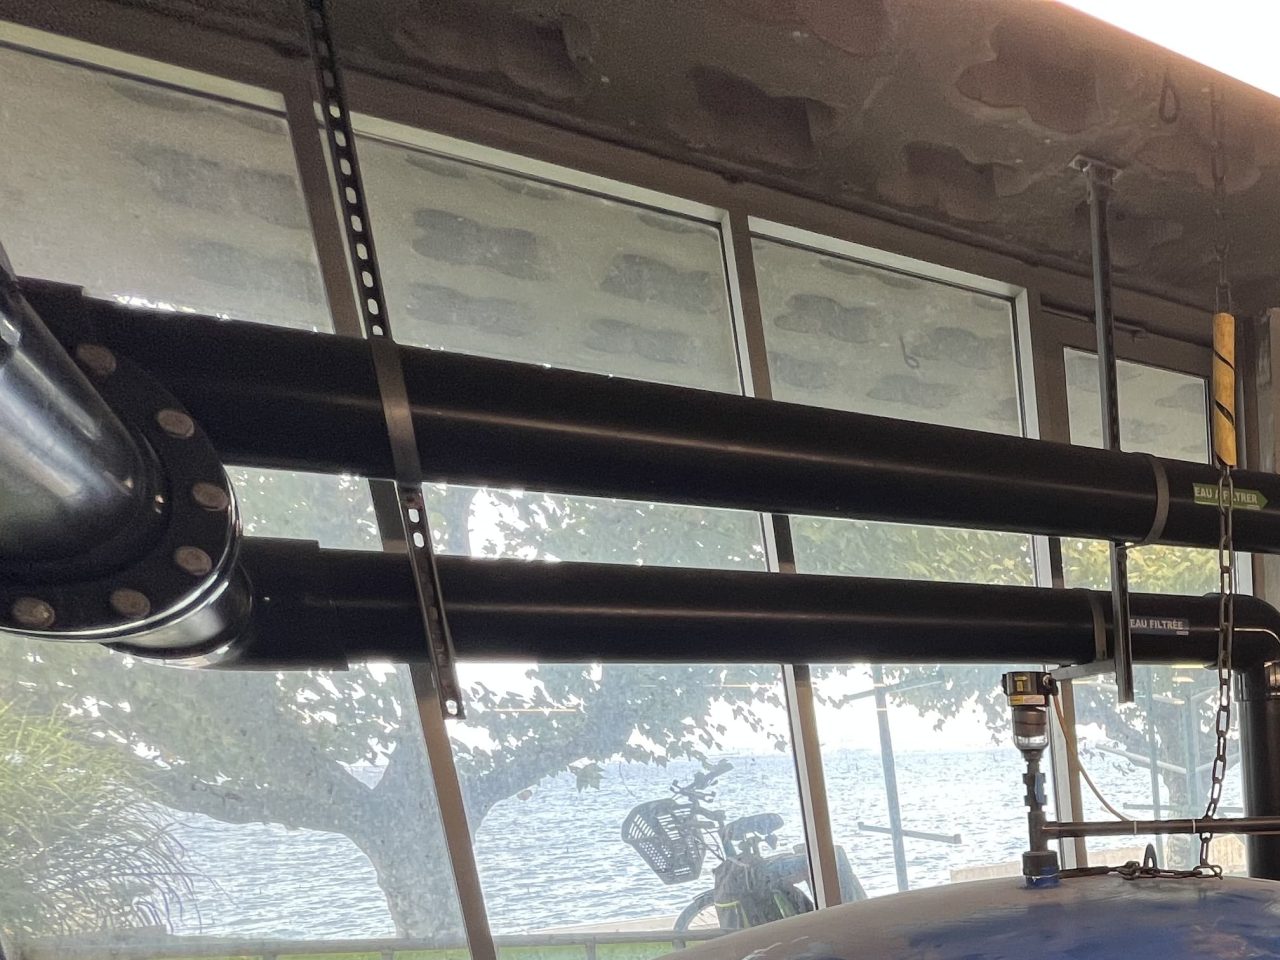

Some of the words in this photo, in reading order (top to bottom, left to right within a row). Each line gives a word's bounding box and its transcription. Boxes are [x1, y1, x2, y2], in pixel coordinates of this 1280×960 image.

[1194, 486, 1212, 498] EAU
[1130, 619, 1147, 628] EAU
[1149, 618, 1184, 630] FILTRÉE
